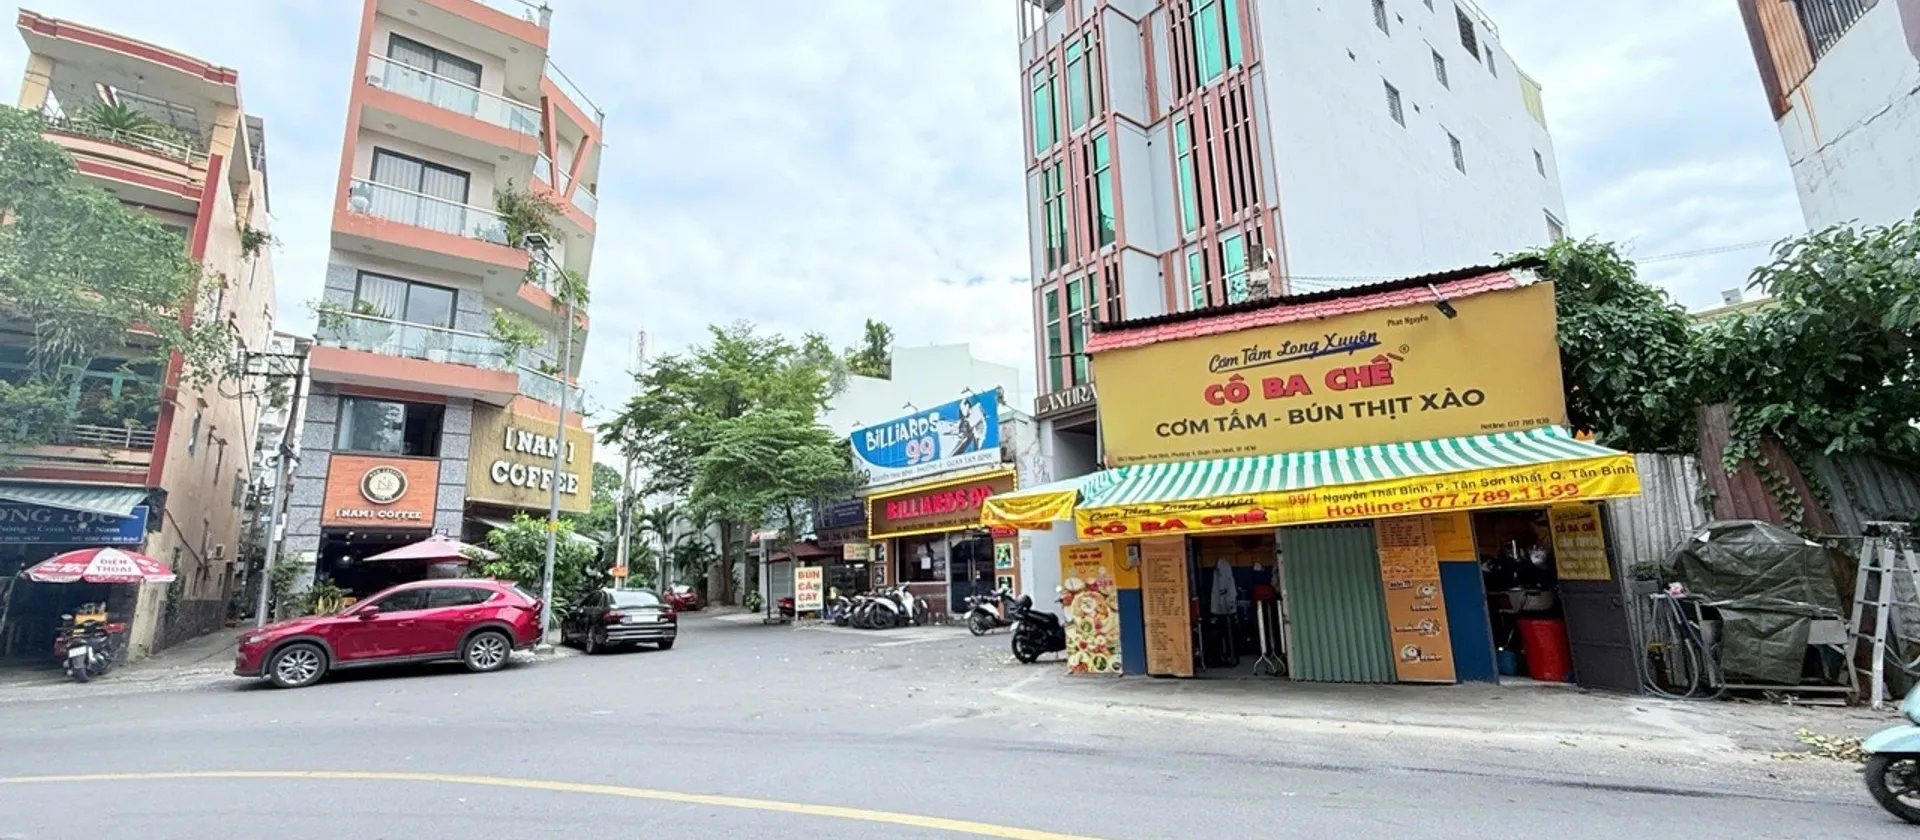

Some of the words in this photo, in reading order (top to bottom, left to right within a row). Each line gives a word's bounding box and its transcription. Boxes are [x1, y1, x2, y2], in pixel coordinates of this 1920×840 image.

[1209, 353, 1238, 373] Cơm
[1241, 344, 1272, 365] Tấm
[1276, 339, 1320, 359] Long
[1323, 330, 1378, 355] Xuyên
[1204, 373, 1251, 406] CÔ
[1262, 374, 1313, 400] BA
[1156, 416, 1210, 438] CƠM
[1214, 407, 1268, 432] TẤM
[1288, 402, 1344, 425] BÚN
[1349, 396, 1413, 420] THỊT
[1419, 388, 1486, 412] XÀO
[905, 435, 935, 465] 99
[1436, 482, 1449, 492] P.
[1452, 479, 1476, 490] Tân
[1480, 475, 1506, 487] Sơn
[1550, 470, 1566, 480] Q.
[1569, 466, 1597, 479] Tân
[1601, 463, 1635, 476] Bình
[377, 509, 423, 520] COFFEE
[886, 488, 968, 520] BILLIARDS
[1326, 500, 1411, 518] Hotline:
[1419, 482, 1579, 509] 077.789.1139
[1083, 520, 1127, 536] CÔ
[1140, 517, 1189, 532] BA
